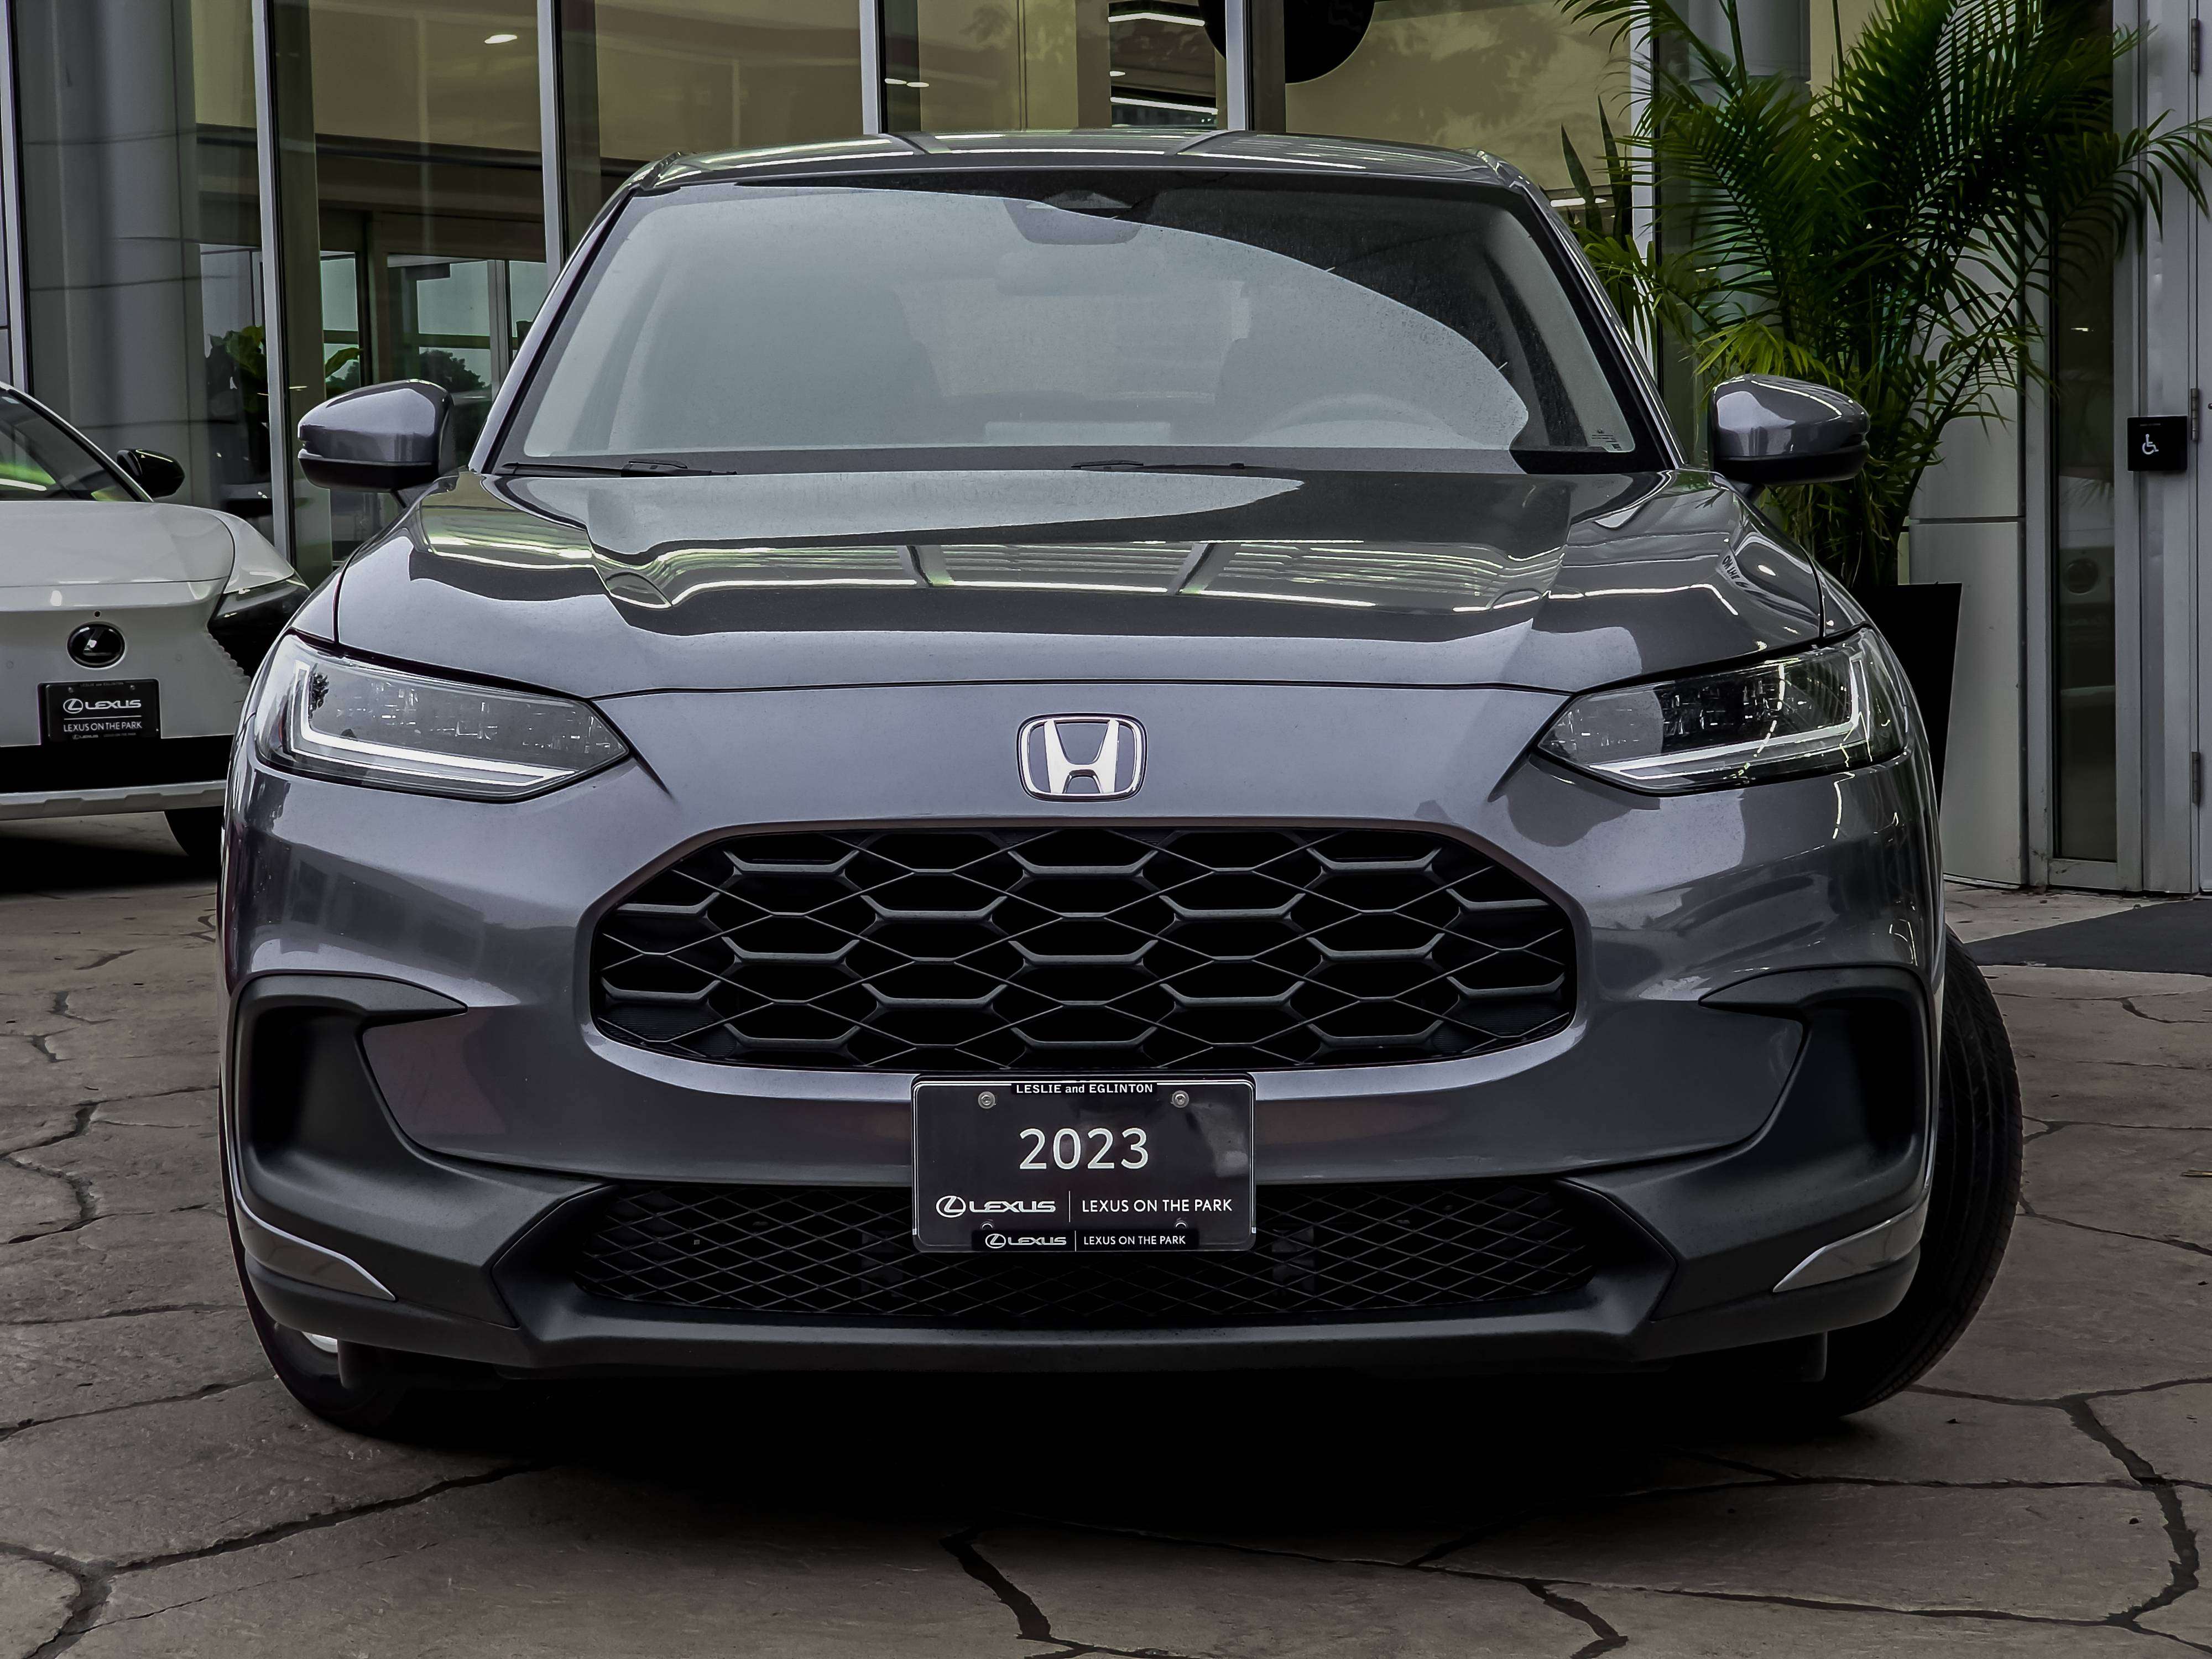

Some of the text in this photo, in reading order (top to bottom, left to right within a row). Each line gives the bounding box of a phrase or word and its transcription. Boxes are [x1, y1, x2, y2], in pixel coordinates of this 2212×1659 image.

[85, 700, 142, 710] LEXUS
[63, 723, 90, 732] LEXUS
[105, 722, 120, 730] THE
[121, 721, 143, 729] PARK
[1016, 1084, 1152, 1094] LESLIE and EGLINTON
[1019, 1127, 1149, 1170] 2023
[969, 1201, 1056, 1213] LEXUS
[1082, 1199, 1233, 1212] LEXUS ON THE PARK
[1008, 1237, 1067, 1245] LEXUS
[1084, 1235, 1186, 1245] LEXUS ON THE PARK
